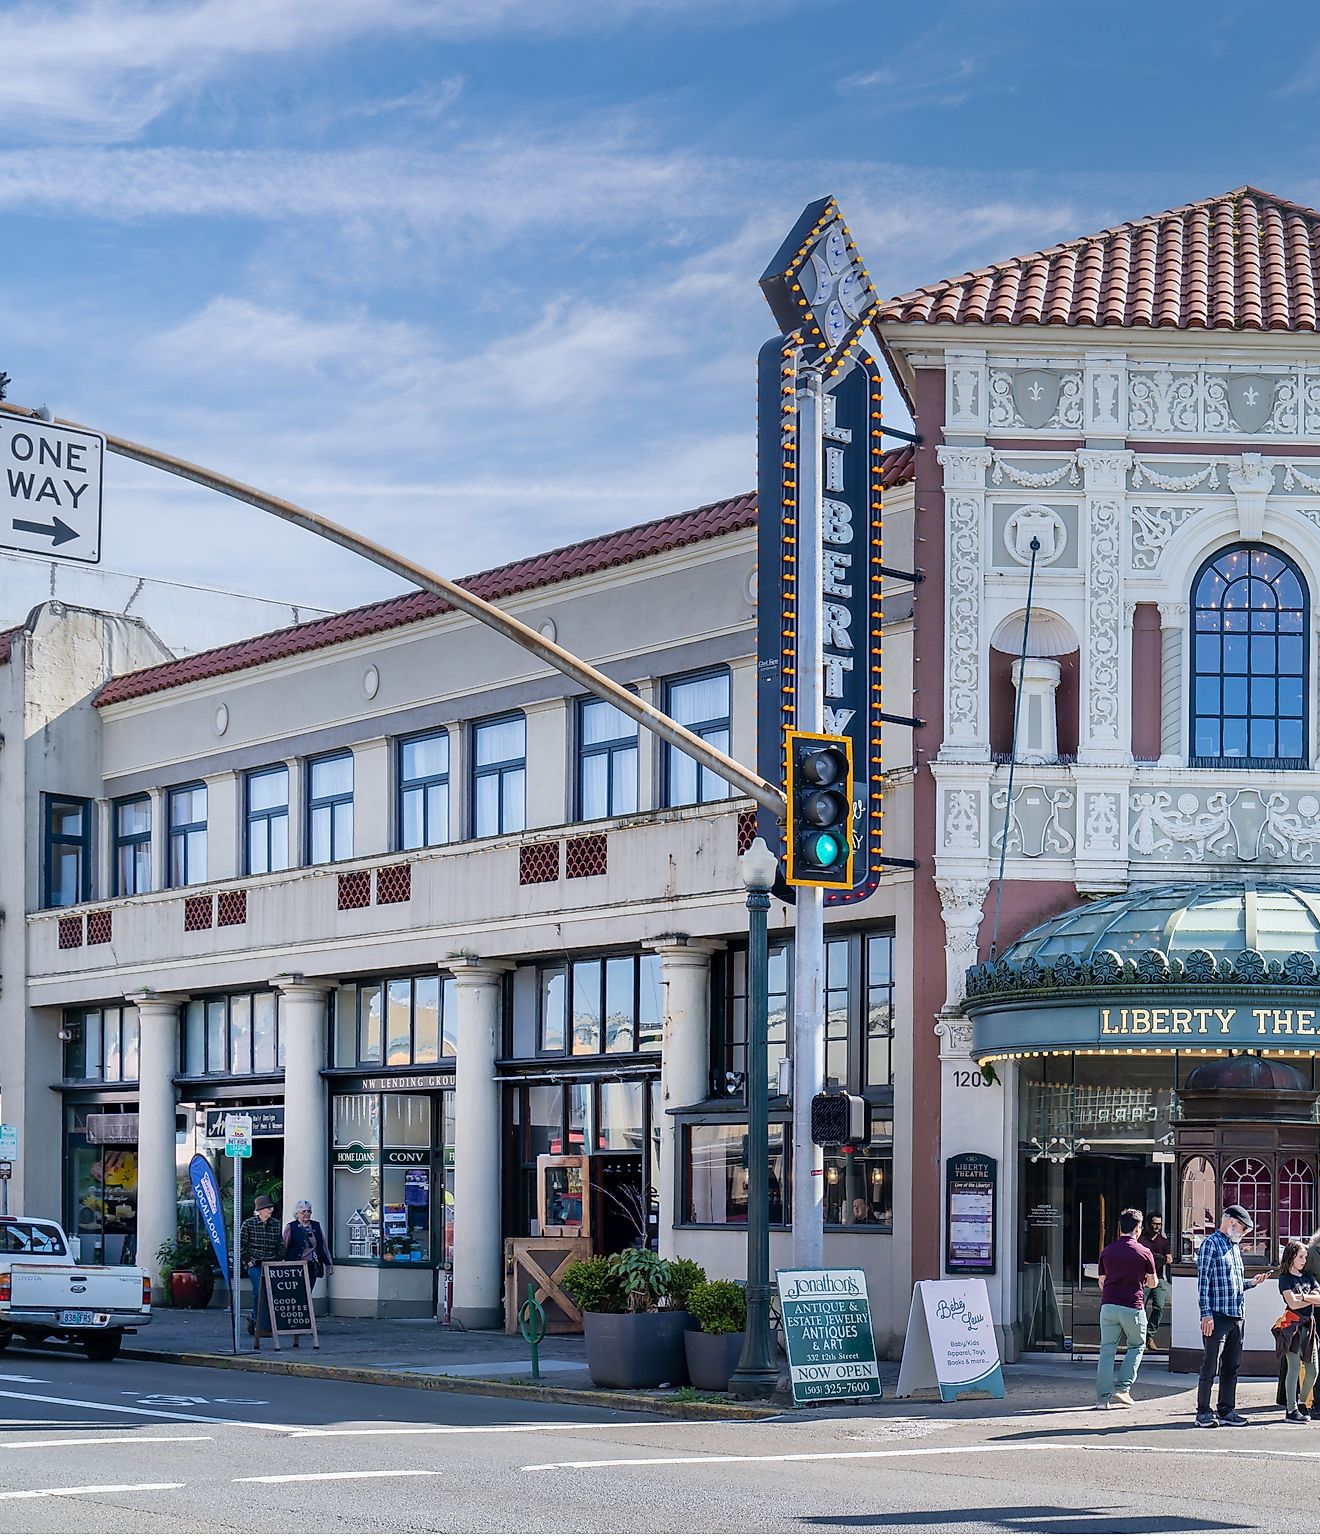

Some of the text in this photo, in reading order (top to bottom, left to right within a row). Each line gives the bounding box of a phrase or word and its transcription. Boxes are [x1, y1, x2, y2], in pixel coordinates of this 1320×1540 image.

[10, 433, 88, 474] ONE
[7, 468, 90, 510] WAY
[1101, 1008, 1237, 1035] LIBERTY
[362, 1079, 376, 1089] NW
[381, 1076, 424, 1089] LENDING
[338, 1152, 375, 1162] HOME LOANS
[389, 1152, 424, 1162] CONV
[954, 1163, 989, 1171] LIBERTY
[954, 1170, 989, 1178] THEATRE
[194, 1183, 209, 1220] LOCAL
[204, 1216, 221, 1245] LOOP
[269, 1268, 304, 1279] RUSTY
[277, 1281, 299, 1290] CUP
[787, 1273, 860, 1299] Jonathon's
[794, 1301, 859, 1315] ANTIQUE &
[787, 1312, 869, 1327] ESTATE JEWELRY
[801, 1325, 859, 1340] ANTIQUES
[812, 1338, 844, 1351] & ART
[806, 1352, 860, 1362] 332 12th Street
[798, 1363, 872, 1380] NOW OPEN
[804, 1380, 871, 1395] (503) 325-7600
